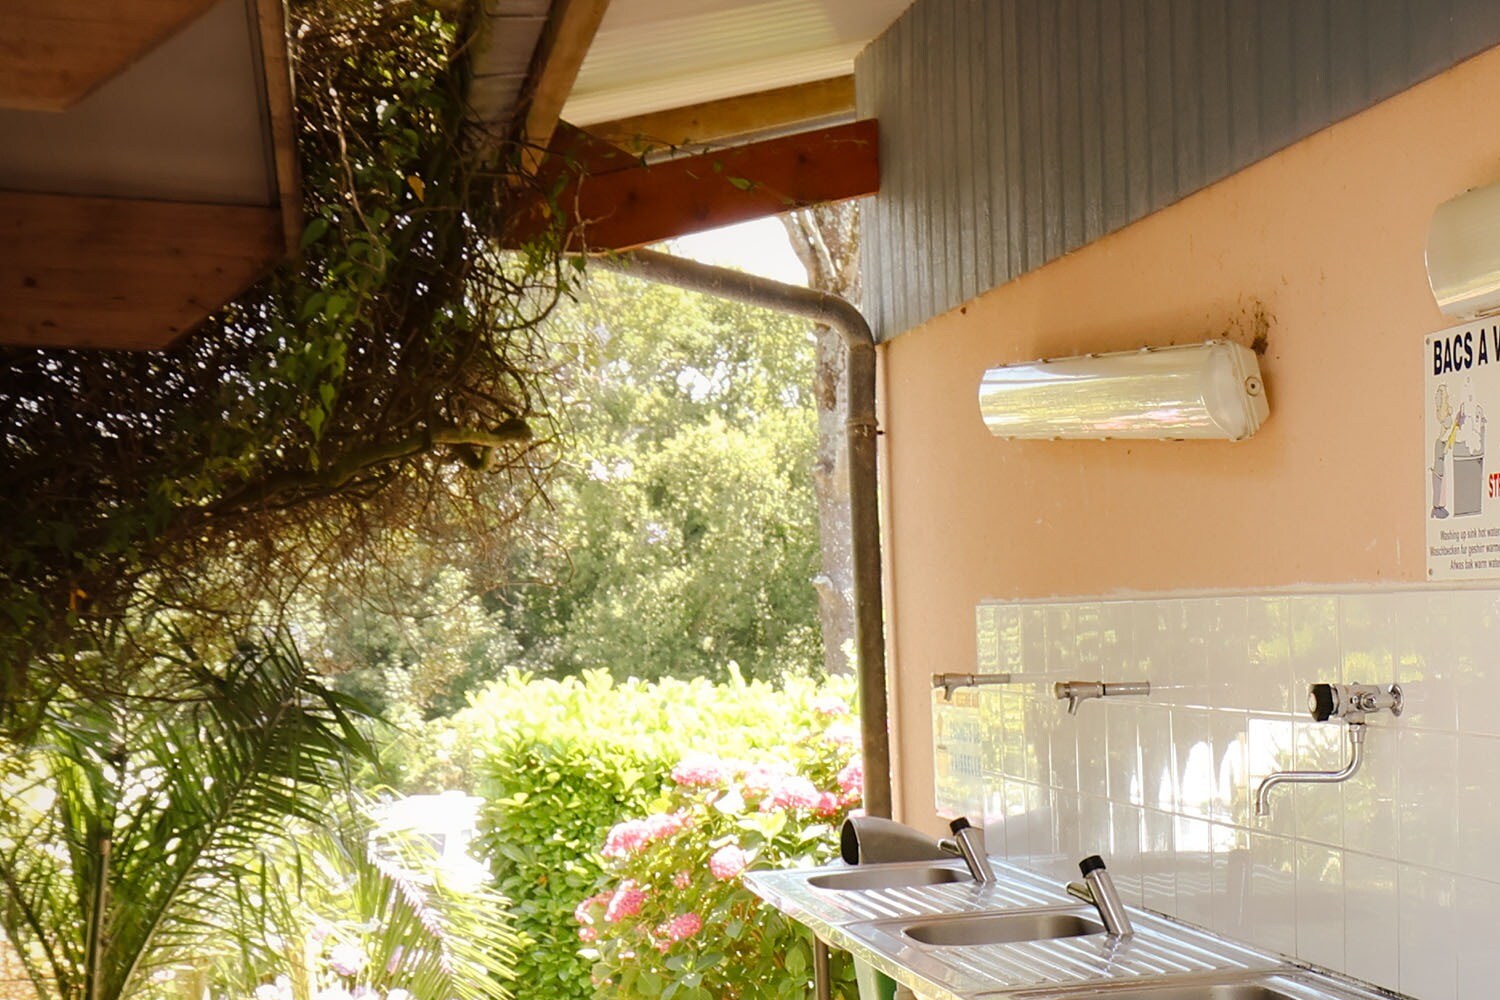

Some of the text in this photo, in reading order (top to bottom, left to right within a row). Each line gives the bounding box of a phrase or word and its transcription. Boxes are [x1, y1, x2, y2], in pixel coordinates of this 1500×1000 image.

[1433, 331, 1473, 375] BACS
[1478, 328, 1488, 366] A
[1440, 529, 1460, 542] Washing
[1478, 527, 1486, 538] hot
[1474, 560, 1487, 569] warm
